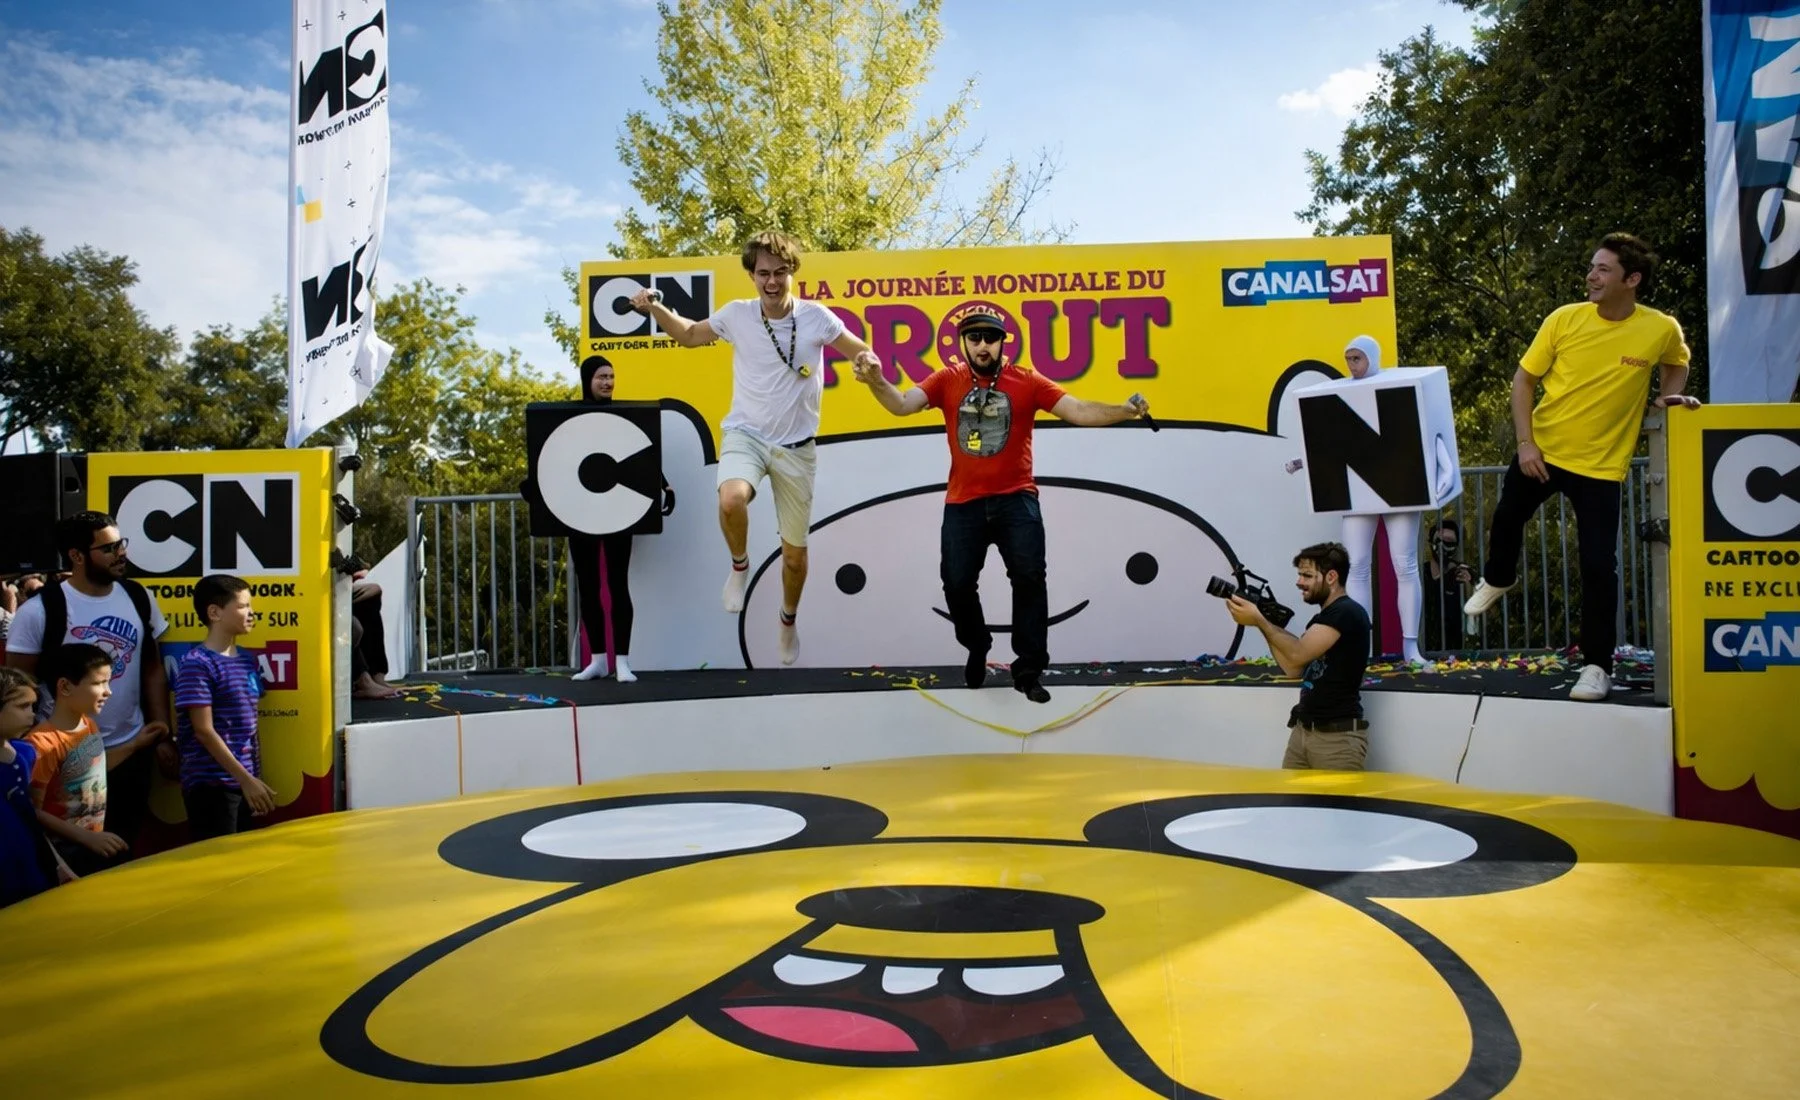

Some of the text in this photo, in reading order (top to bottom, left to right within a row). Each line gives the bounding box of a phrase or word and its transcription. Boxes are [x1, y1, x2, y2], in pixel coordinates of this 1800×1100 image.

[593, 274, 710, 334] CN
[799, 269, 1166, 300] LA JOURNÉE MONDIALE DU
[1227, 268, 1382, 297] CANALSAT
[1298, 385, 1431, 513] N
[537, 411, 654, 535] C
[115, 478, 293, 574] CN
[1743, 581, 1800, 597] EXCL
[267, 611, 300, 627] SUR
